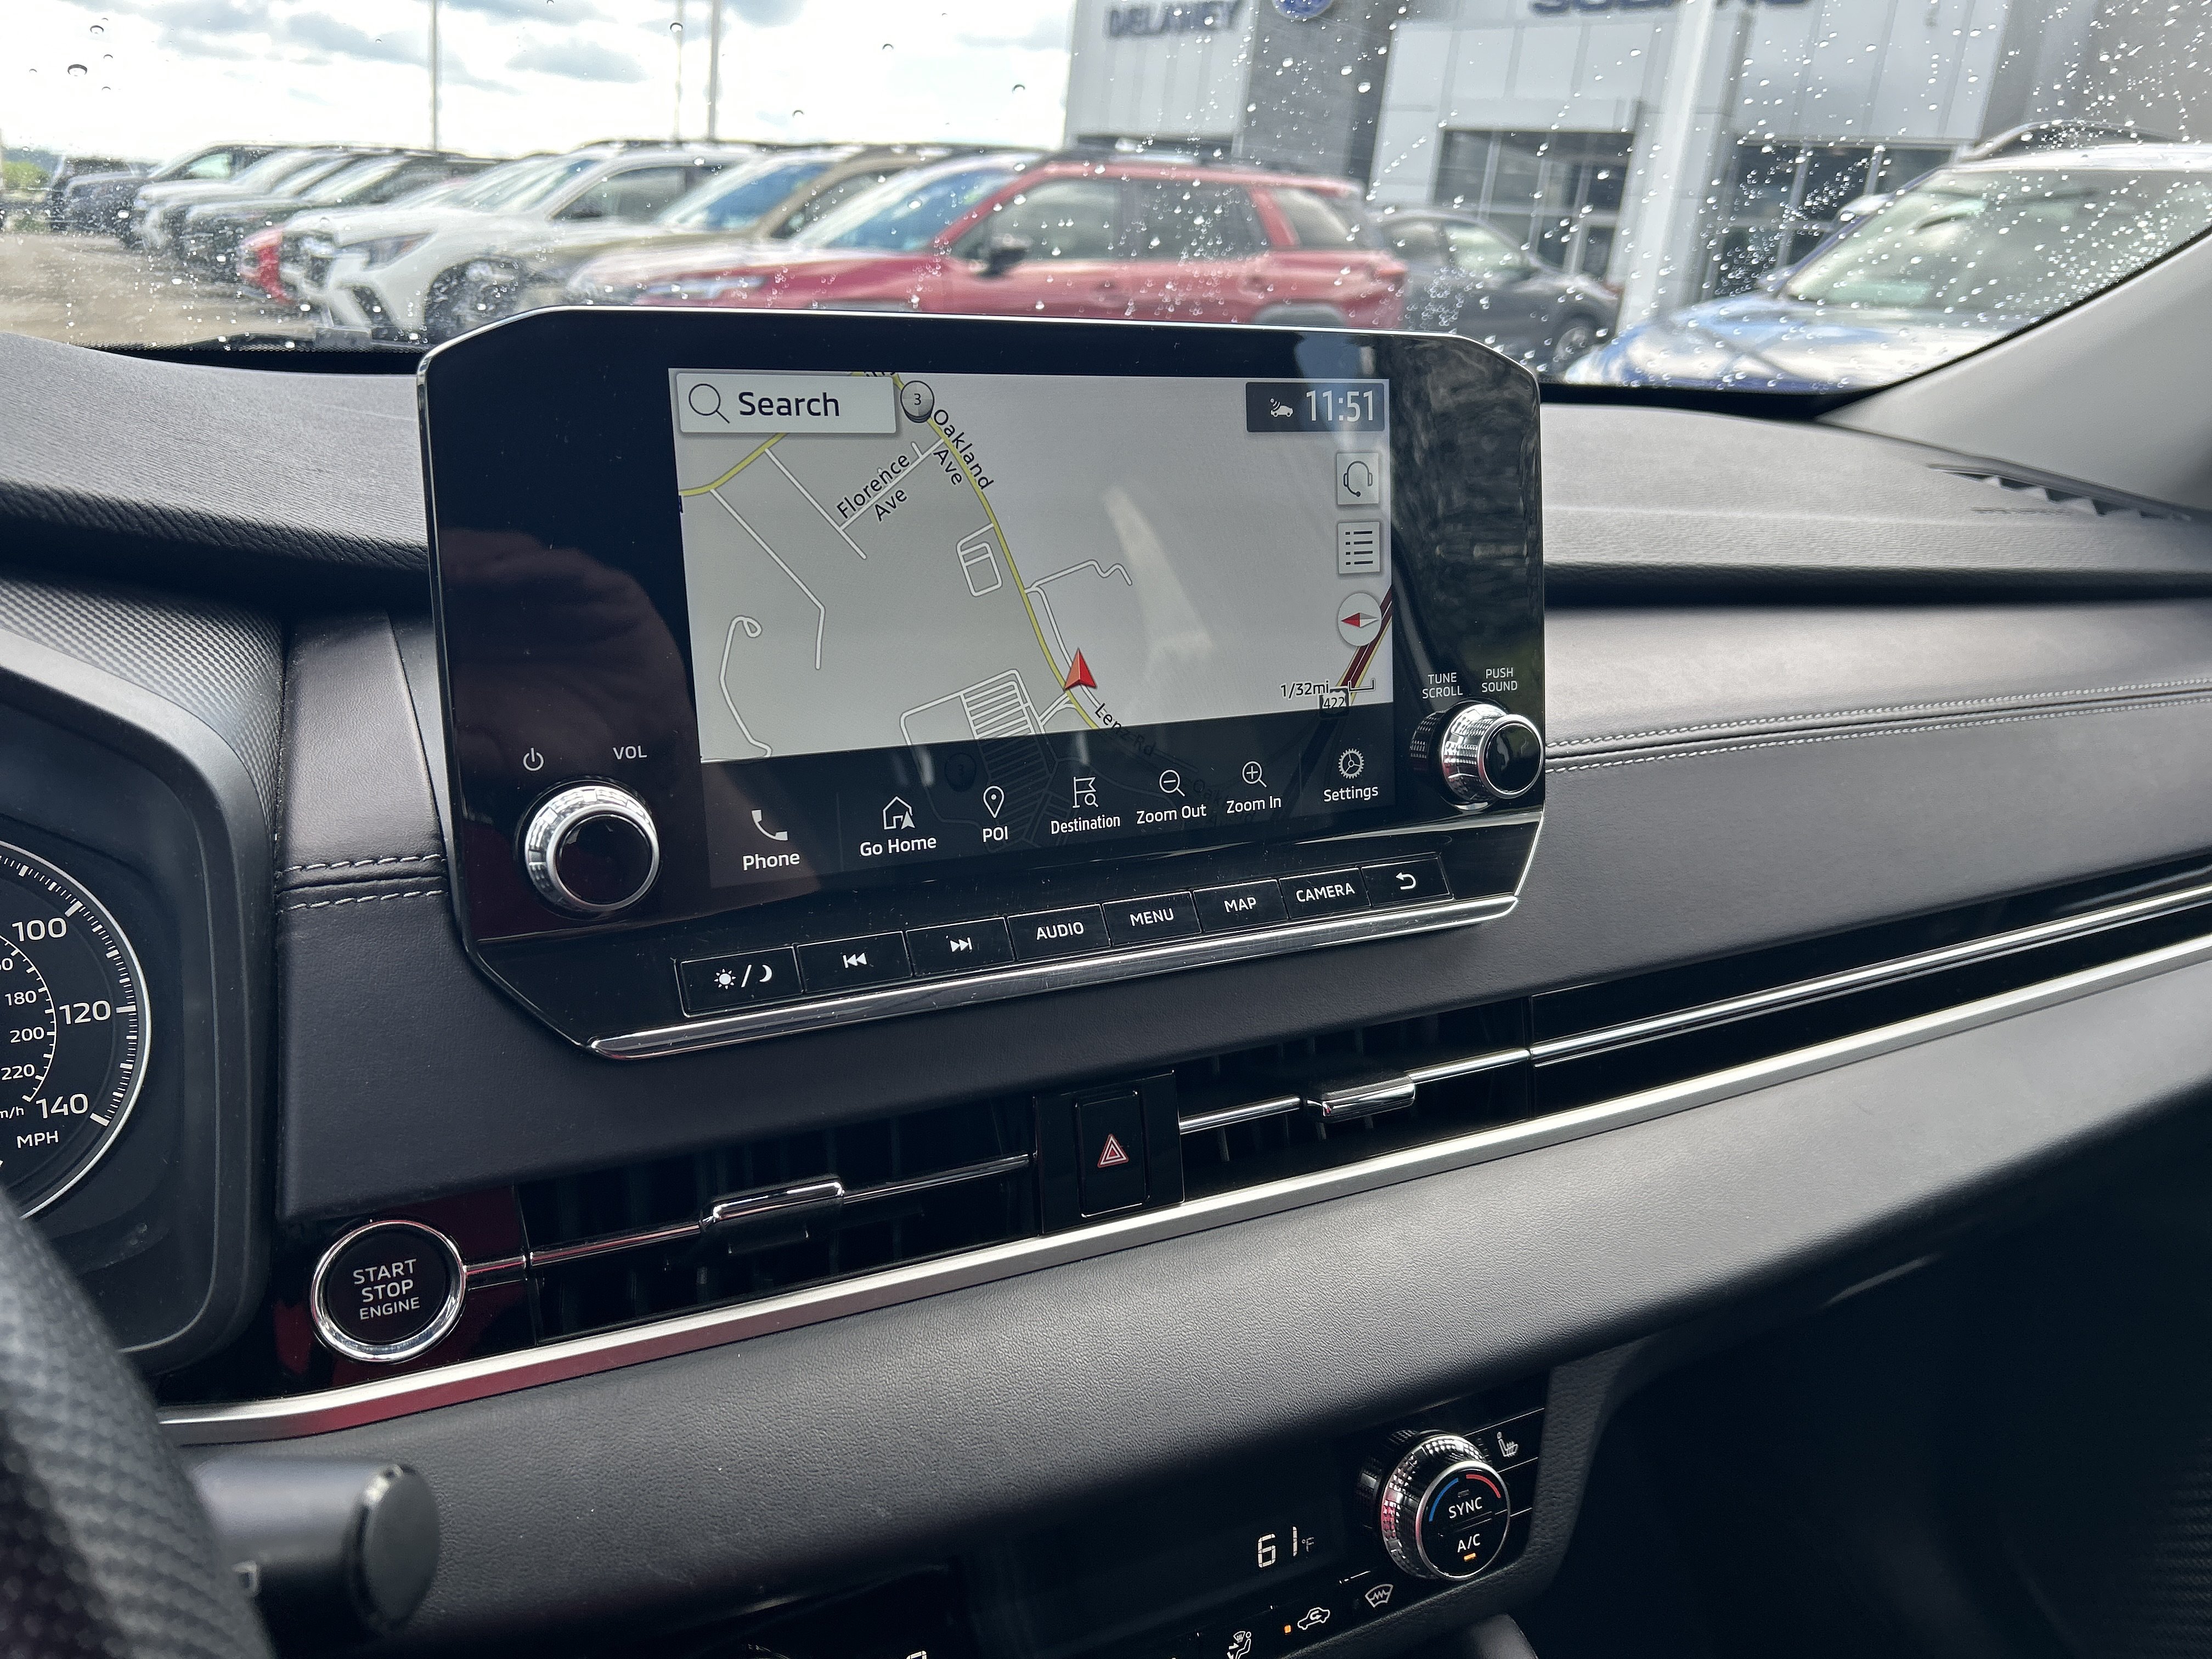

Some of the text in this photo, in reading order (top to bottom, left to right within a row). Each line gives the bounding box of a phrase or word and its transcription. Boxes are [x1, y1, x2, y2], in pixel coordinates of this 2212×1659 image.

[738, 391, 840, 417] Search
[913, 393, 922, 405] 3
[1306, 390, 1374, 422] 11:51
[933, 409, 994, 491] Oakland
[934, 448, 963, 486] Ave
[836, 453, 910, 519] Florence
[873, 488, 908, 522] Ave
[1427, 672, 1457, 685] TUNE
[1486, 667, 1514, 679] PUSH
[1280, 680, 1329, 699] 1/32mi
[1422, 685, 1463, 699] SCROLL
[1481, 681, 1518, 693] SOUND
[1323, 697, 1345, 709] 422
[613, 745, 648, 760] VOL
[1323, 785, 1379, 803] Settings
[1136, 804, 1207, 825] Zoom Out
[1226, 795, 1282, 815] Zoom In
[1050, 814, 1121, 834] Destination
[983, 826, 1008, 843] POI
[860, 837, 936, 856] Go Home
[742, 853, 800, 871] Phone
[1296, 882, 1356, 903] CAMERA
[1224, 896, 1256, 913] MAP
[1130, 908, 1175, 927] MENU
[12, 917, 67, 942] 100
[1036, 922, 1084, 940] AUDIO
[4, 990, 37, 1006] 180
[59, 1000, 111, 1025] 120
[9, 1026, 45, 1043] 200
[1, 1063, 35, 1081] 220
[36, 1093, 89, 1119] 140
[16, 1130, 59, 1148] MPH
[353, 1259, 417, 1285] START
[361, 1279, 414, 1302] STOP
[359, 1296, 420, 1321] ENGINE
[1448, 1496, 1483, 1519] SYNC
[1457, 1533, 1481, 1554] A/C
